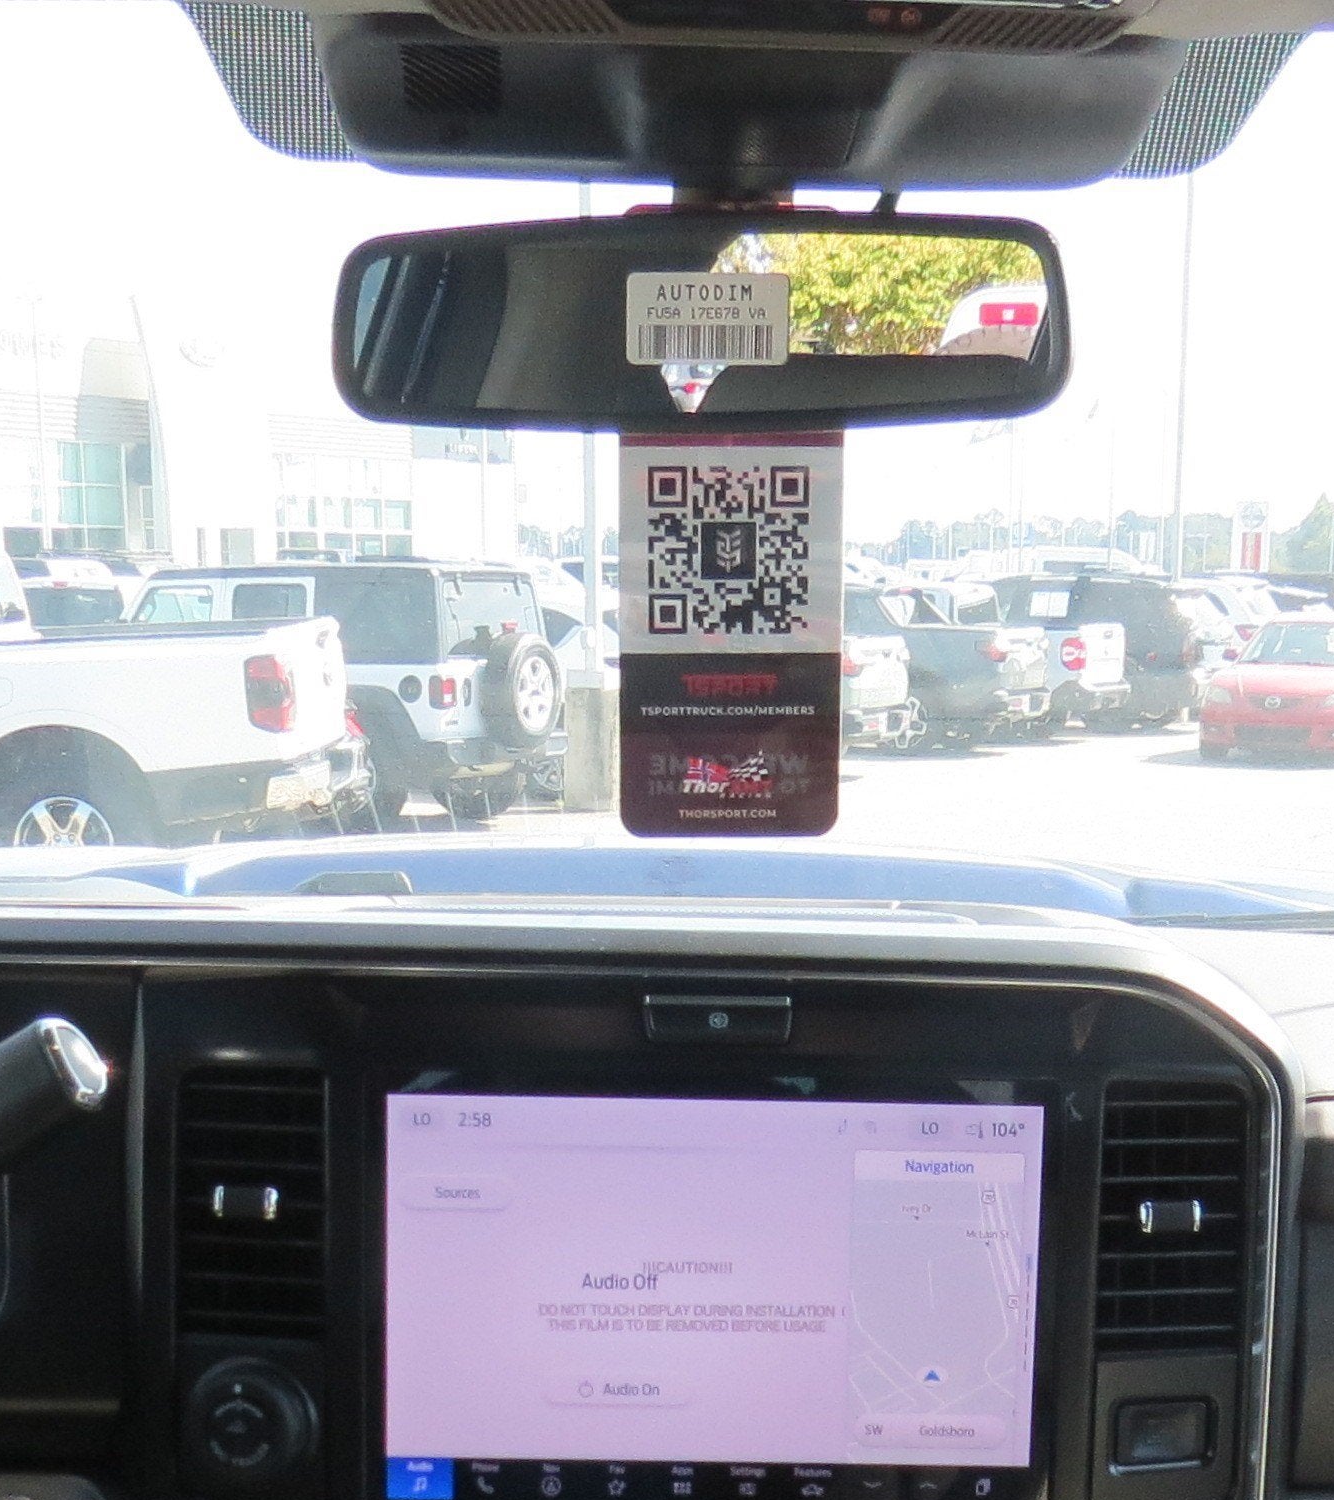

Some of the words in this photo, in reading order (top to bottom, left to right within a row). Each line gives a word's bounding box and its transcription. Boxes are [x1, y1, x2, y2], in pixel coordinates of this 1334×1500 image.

[656, 284, 753, 301] AUTODIM
[640, 705, 816, 717] TSPORTTRUCK.COM/MEMBERS
[678, 809, 777, 819] THORSPORT.COM
[412, 1112, 432, 1127] LO
[457, 1112, 493, 1128] 2:58
[921, 1121, 940, 1135] LO
[991, 1122, 1026, 1138] 104°
[905, 1159, 976, 1175] Navigation
[581, 1272, 630, 1290] Audio
[633, 1272, 659, 1290] Off
[589, 1303, 635, 1316] TOUCH
[745, 1304, 835, 1318] INSTALLATION
[666, 1319, 729, 1333] REMOVED
[603, 1382, 639, 1396] Audio
[641, 1382, 660, 1396] On
[919, 1425, 975, 1437] Goldsboro
